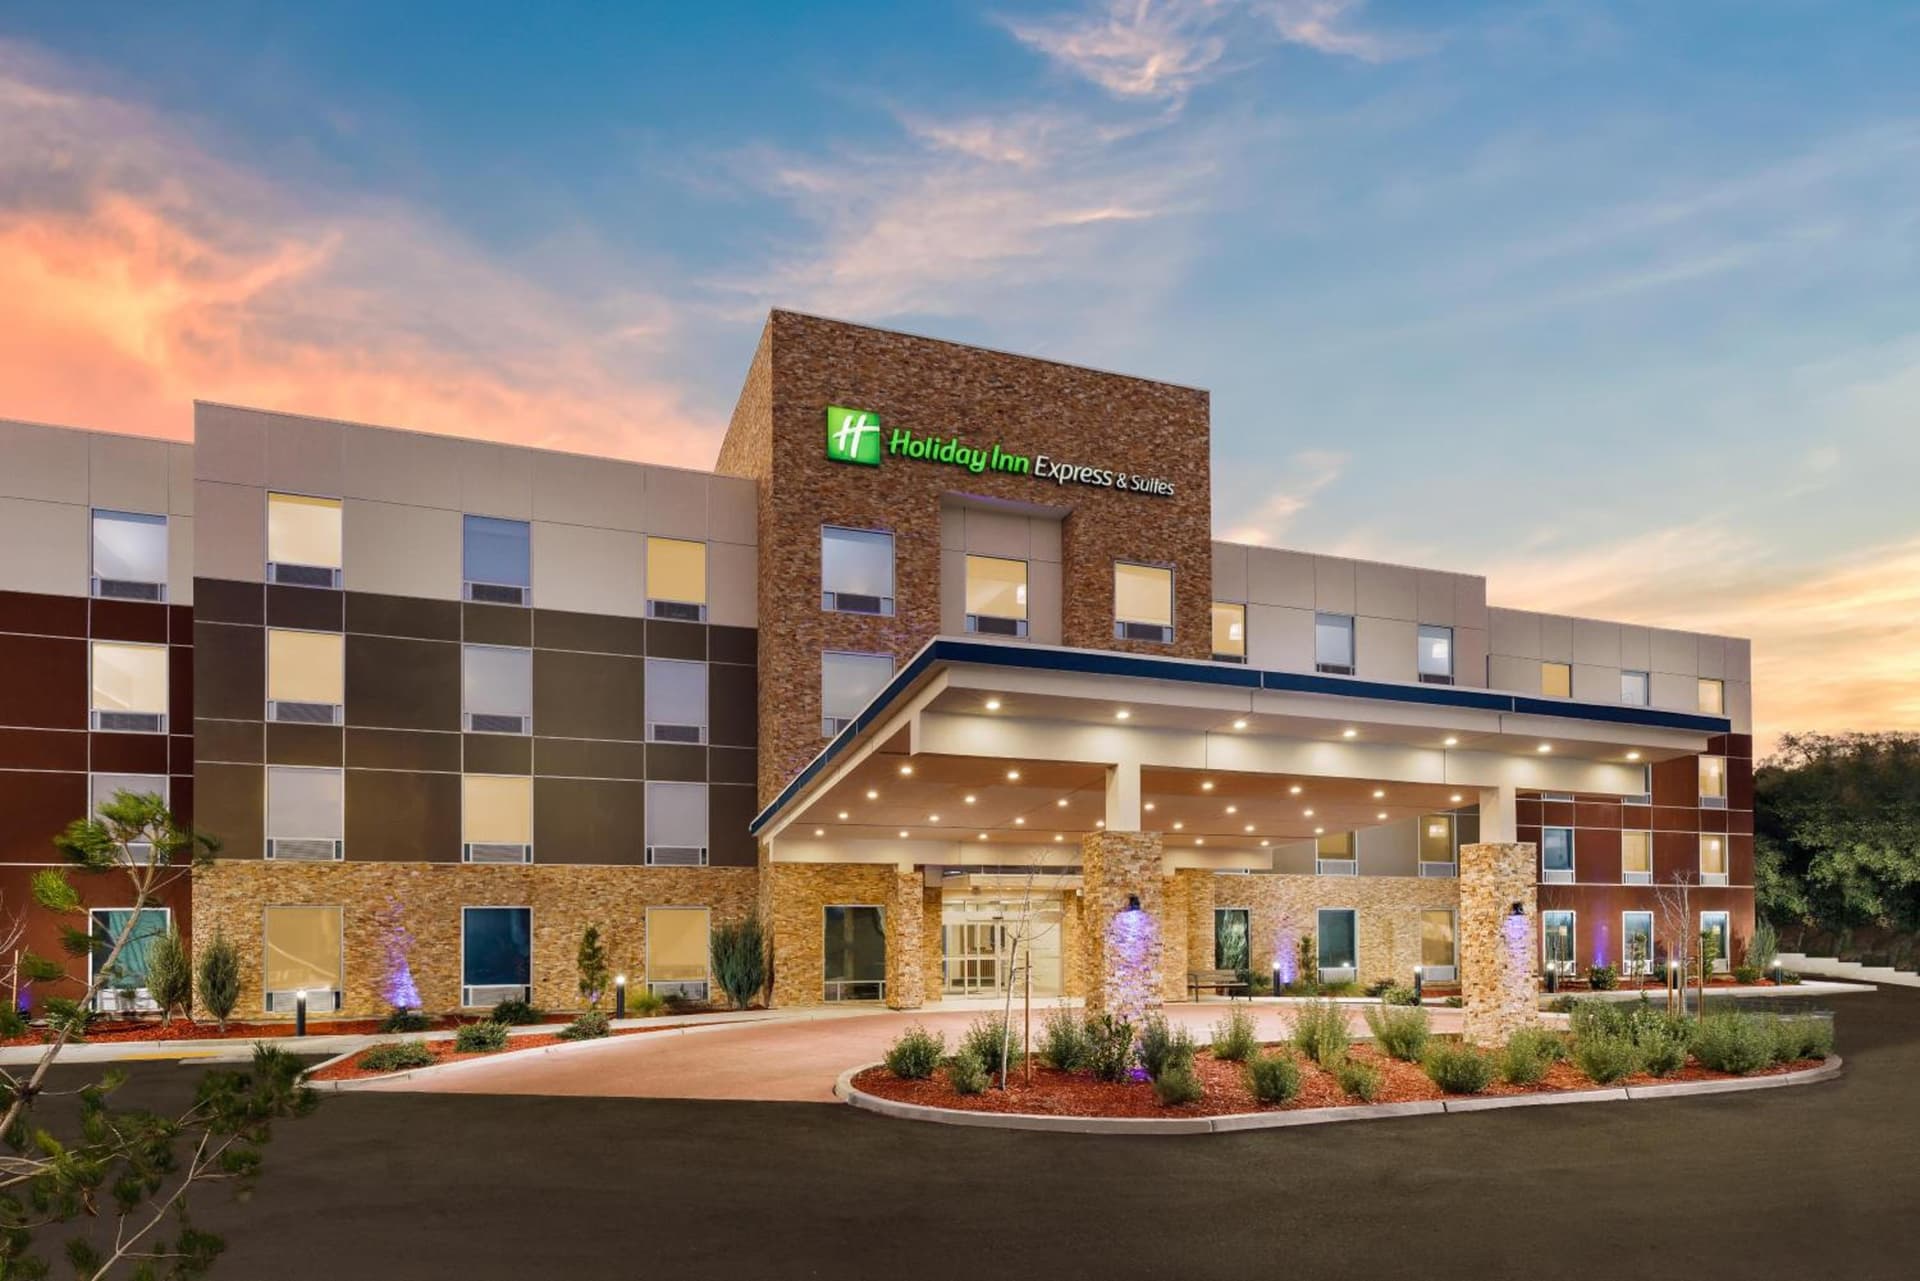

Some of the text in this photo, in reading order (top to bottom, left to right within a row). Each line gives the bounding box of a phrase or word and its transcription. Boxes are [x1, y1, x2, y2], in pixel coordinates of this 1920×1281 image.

[888, 428, 1175, 496] Holiday Inn Express & Suites
